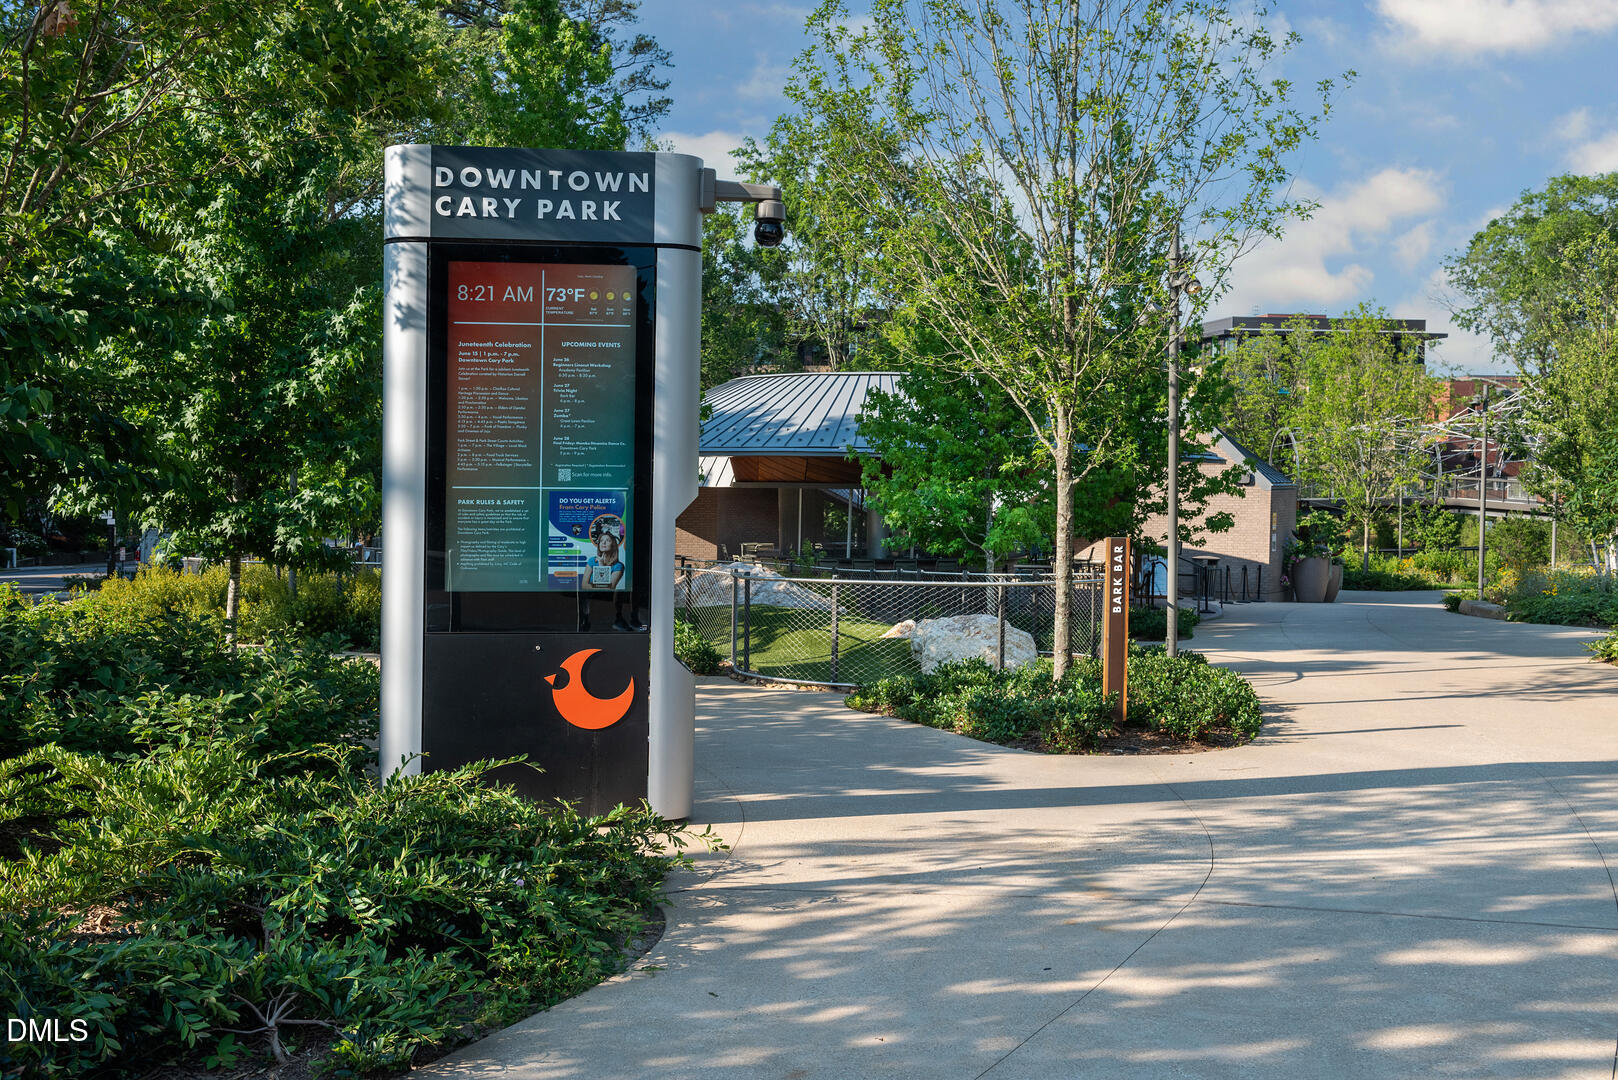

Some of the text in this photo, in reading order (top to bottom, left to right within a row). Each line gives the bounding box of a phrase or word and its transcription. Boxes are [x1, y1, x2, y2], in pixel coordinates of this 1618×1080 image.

[435, 166, 648, 192] DOWNTOWN
[435, 196, 622, 220] CARY PARK
[458, 284, 534, 302] 8:21 AM
[546, 288, 585, 302] 73°F
[1112, 546, 1124, 613] BARK BAR
